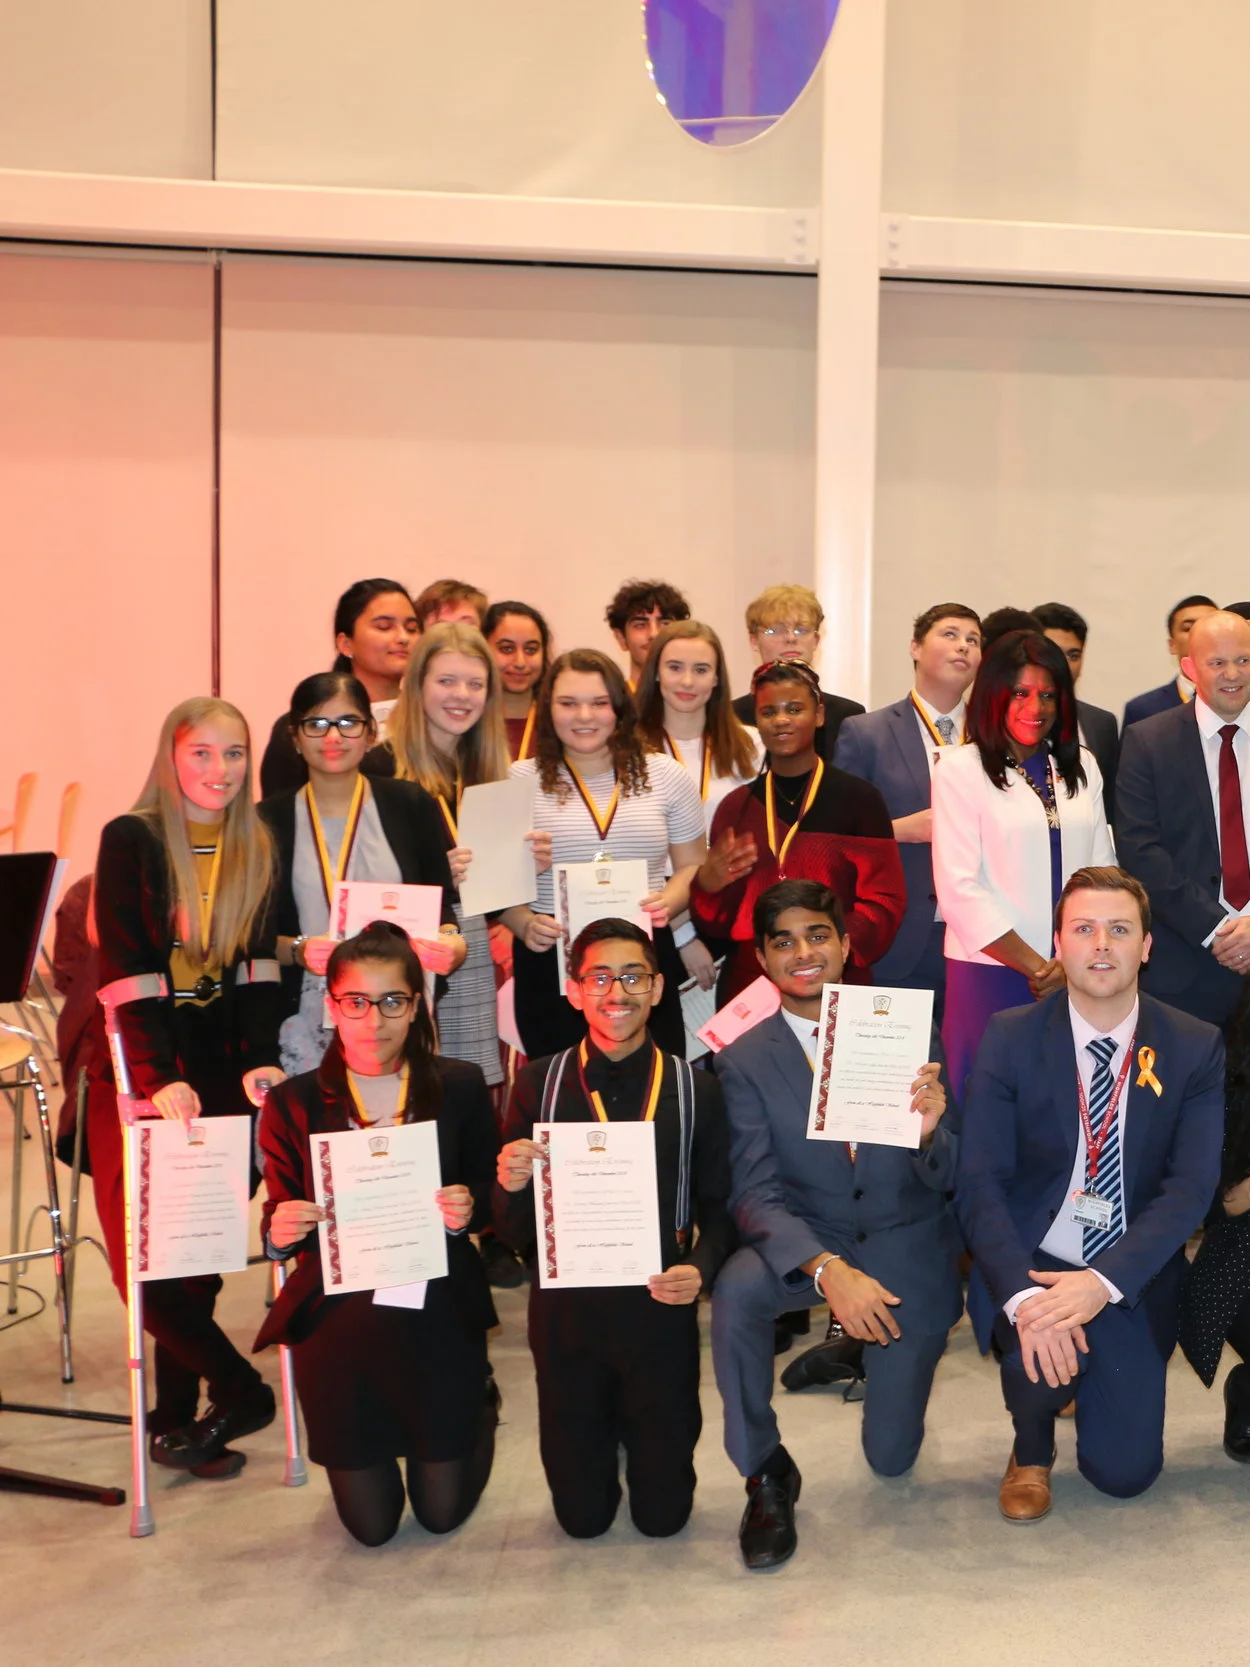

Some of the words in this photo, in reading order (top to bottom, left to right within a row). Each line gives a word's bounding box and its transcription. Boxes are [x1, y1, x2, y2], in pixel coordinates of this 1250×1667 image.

[1108, 1081, 1122, 1111] HIGHFIELDS
[1082, 1113, 1094, 1142] HIGHFIELDS
[1102, 1110, 1111, 1128] SCHOOL
